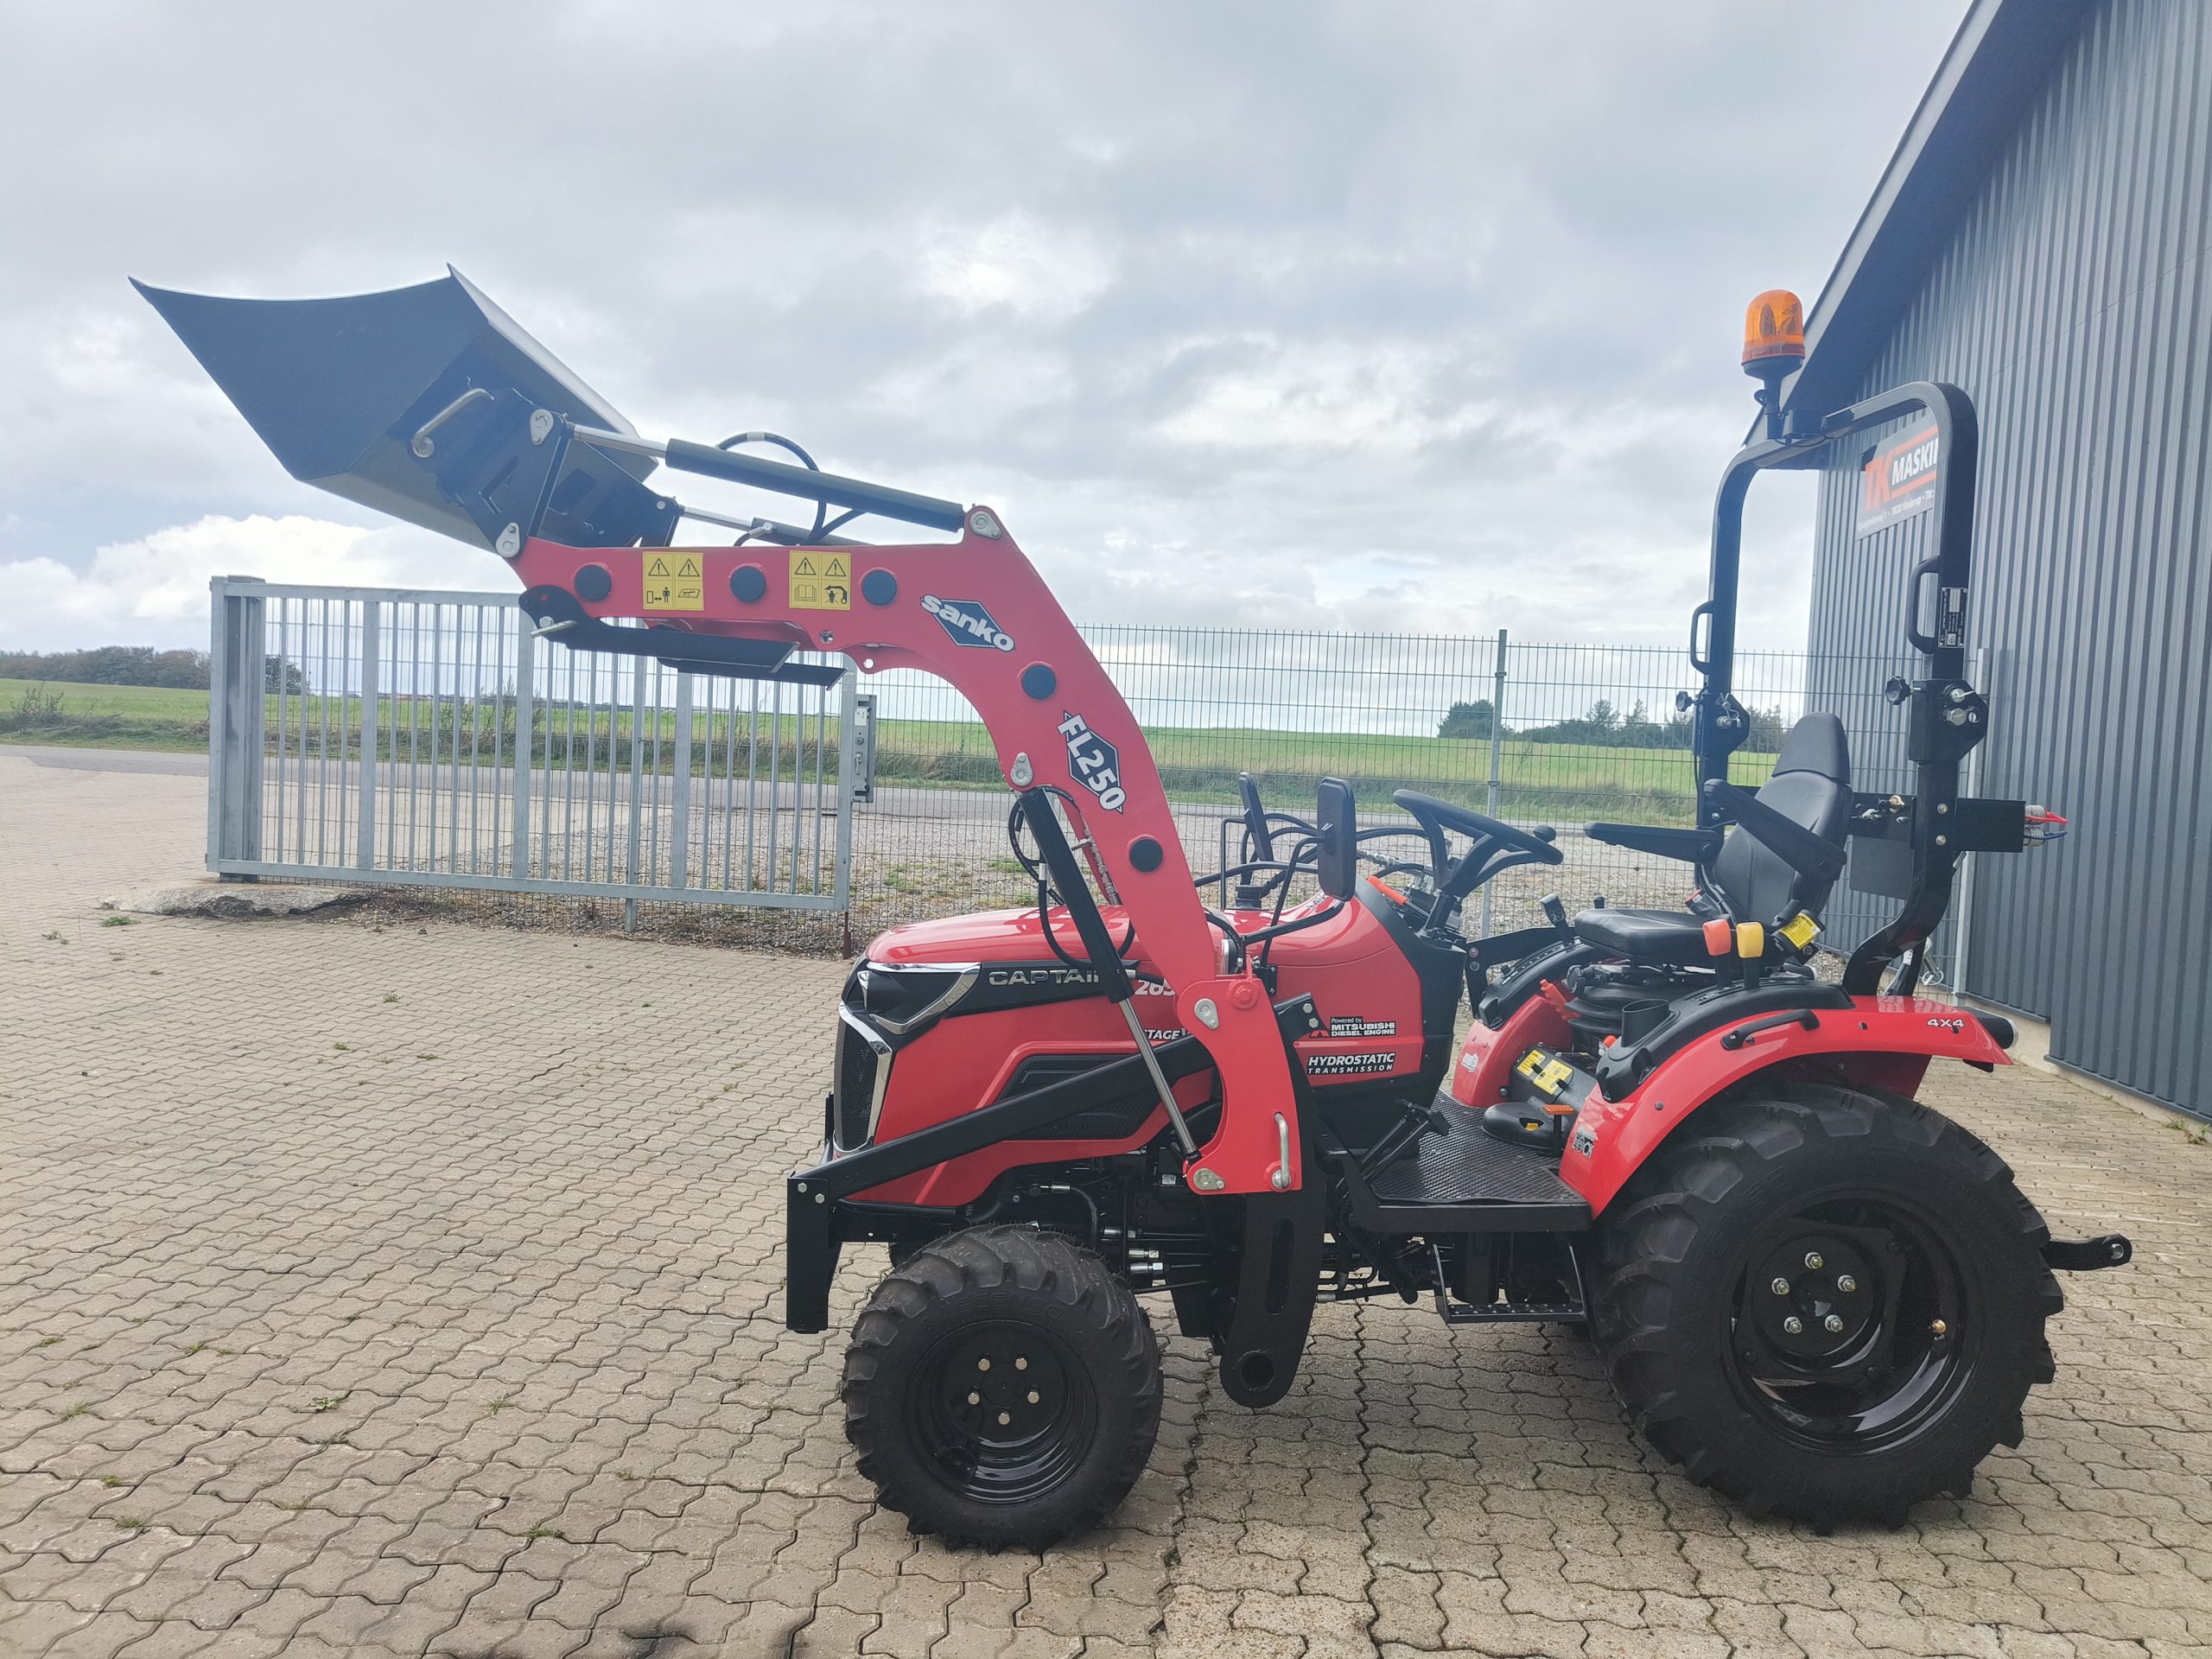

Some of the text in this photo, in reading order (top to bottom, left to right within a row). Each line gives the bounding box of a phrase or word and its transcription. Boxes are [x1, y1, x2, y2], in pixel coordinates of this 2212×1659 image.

[921, 594, 1015, 652] sanko
[1058, 714, 1127, 810] FL250
[1332, 1022, 1395, 1031] MITSUBISHI
[1144, 1029, 1180, 1040] TAGE
[1308, 1052, 1395, 1066] HYDROSTATIC
[1307, 1064, 1393, 1075] TRANSMISSION
